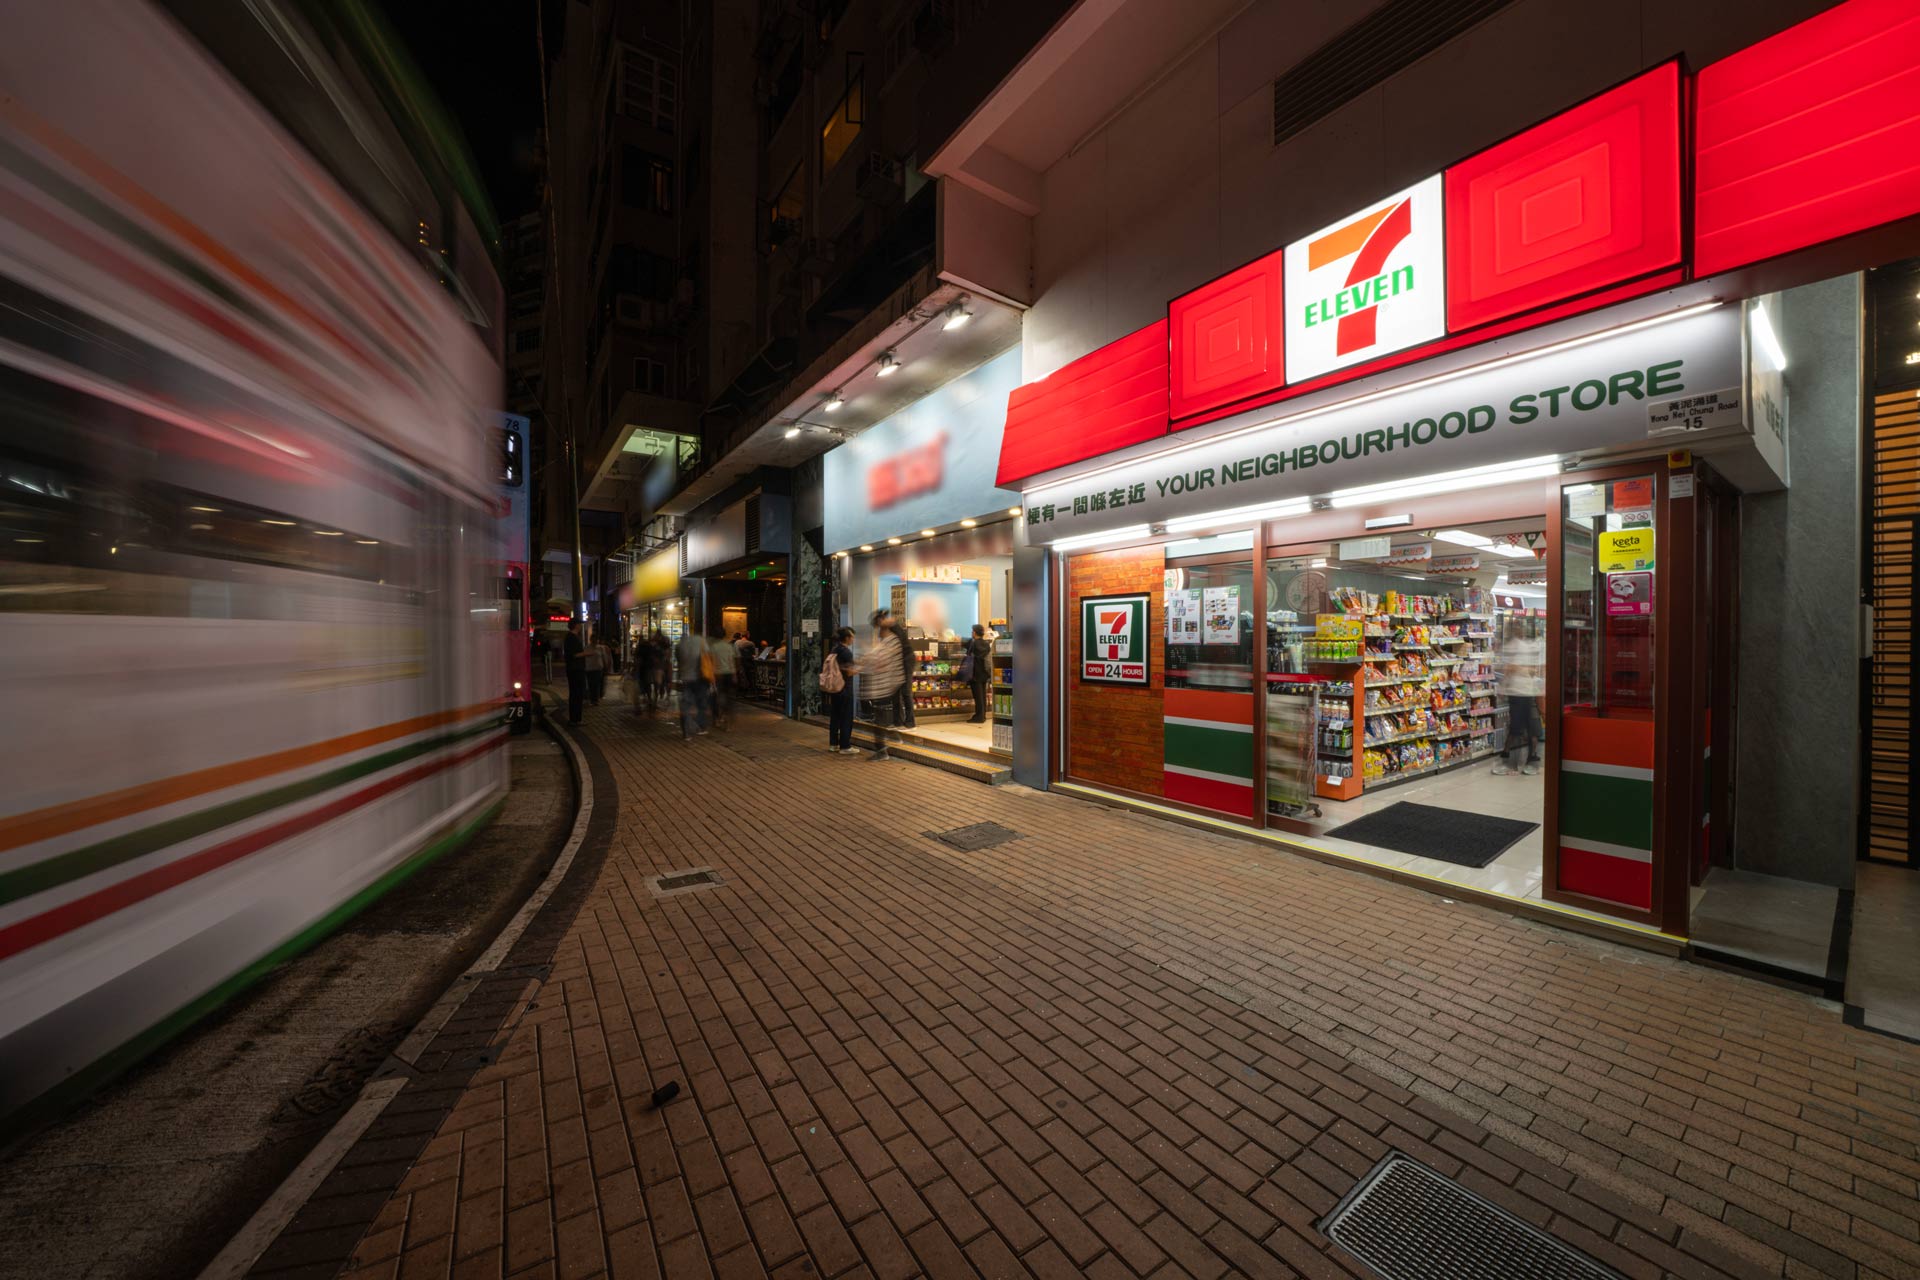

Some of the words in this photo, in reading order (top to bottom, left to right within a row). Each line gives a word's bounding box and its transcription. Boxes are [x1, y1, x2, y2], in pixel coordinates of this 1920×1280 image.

[1308, 196, 1412, 357] 7
[1651, 415, 1669, 423] Wong
[1672, 411, 1686, 419] Nei
[1689, 406, 1714, 416] Chung
[1718, 400, 1739, 410] Road
[505, 418, 520, 431] 78
[1156, 468, 1214, 497] YOUR
[1221, 405, 1496, 485] NEIGHBOURHOOD
[1509, 360, 1684, 424] STORE
[1683, 416, 1703, 430] 15
[1612, 536, 1640, 548] keeta
[1100, 611, 1127, 660] 7
[1106, 664, 1121, 678] 24
[509, 706, 524, 718] 78
